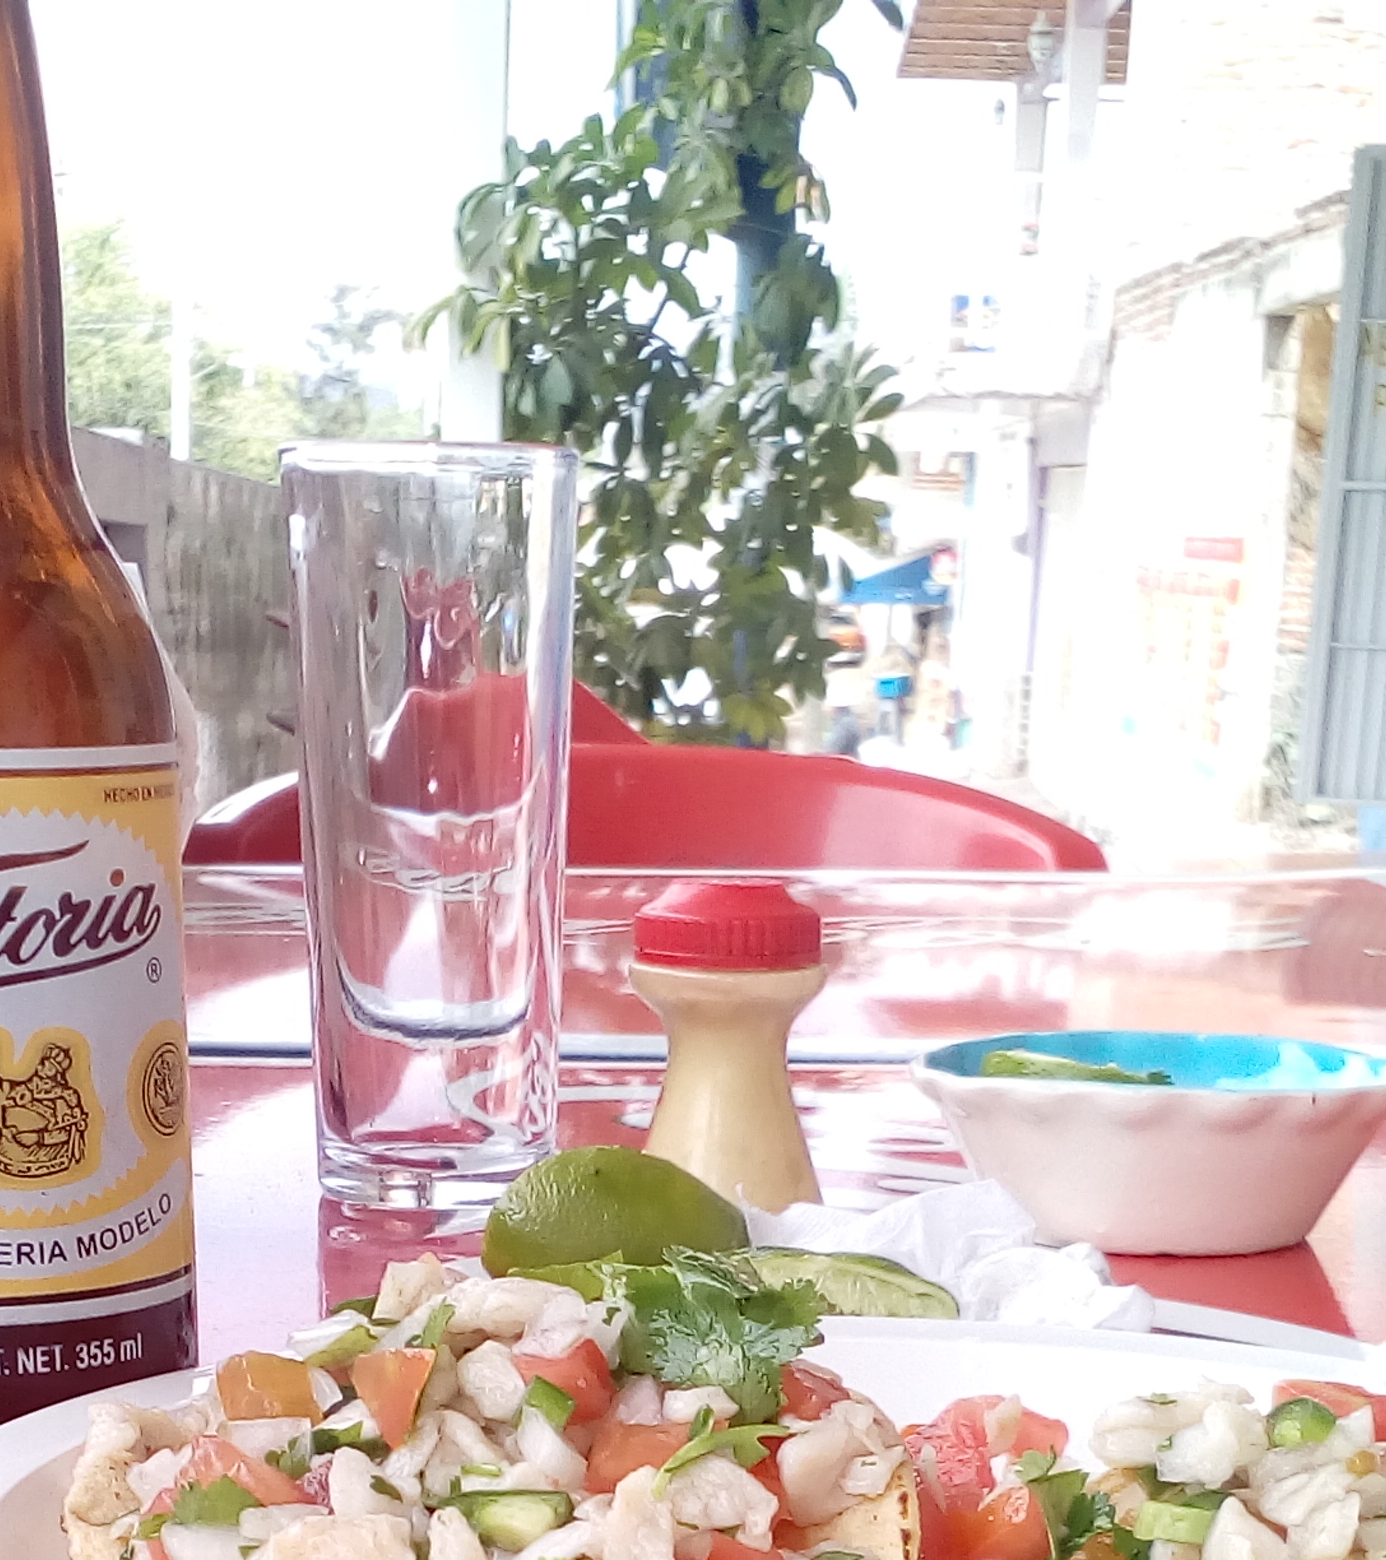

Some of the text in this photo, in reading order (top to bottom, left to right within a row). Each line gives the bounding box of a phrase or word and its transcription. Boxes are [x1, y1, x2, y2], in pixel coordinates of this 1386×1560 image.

[76, 1191, 174, 1262] MODELO
[16, 1344, 70, 1375] NET.
[75, 1341, 115, 1367] 355
[119, 1334, 143, 1362] ml
